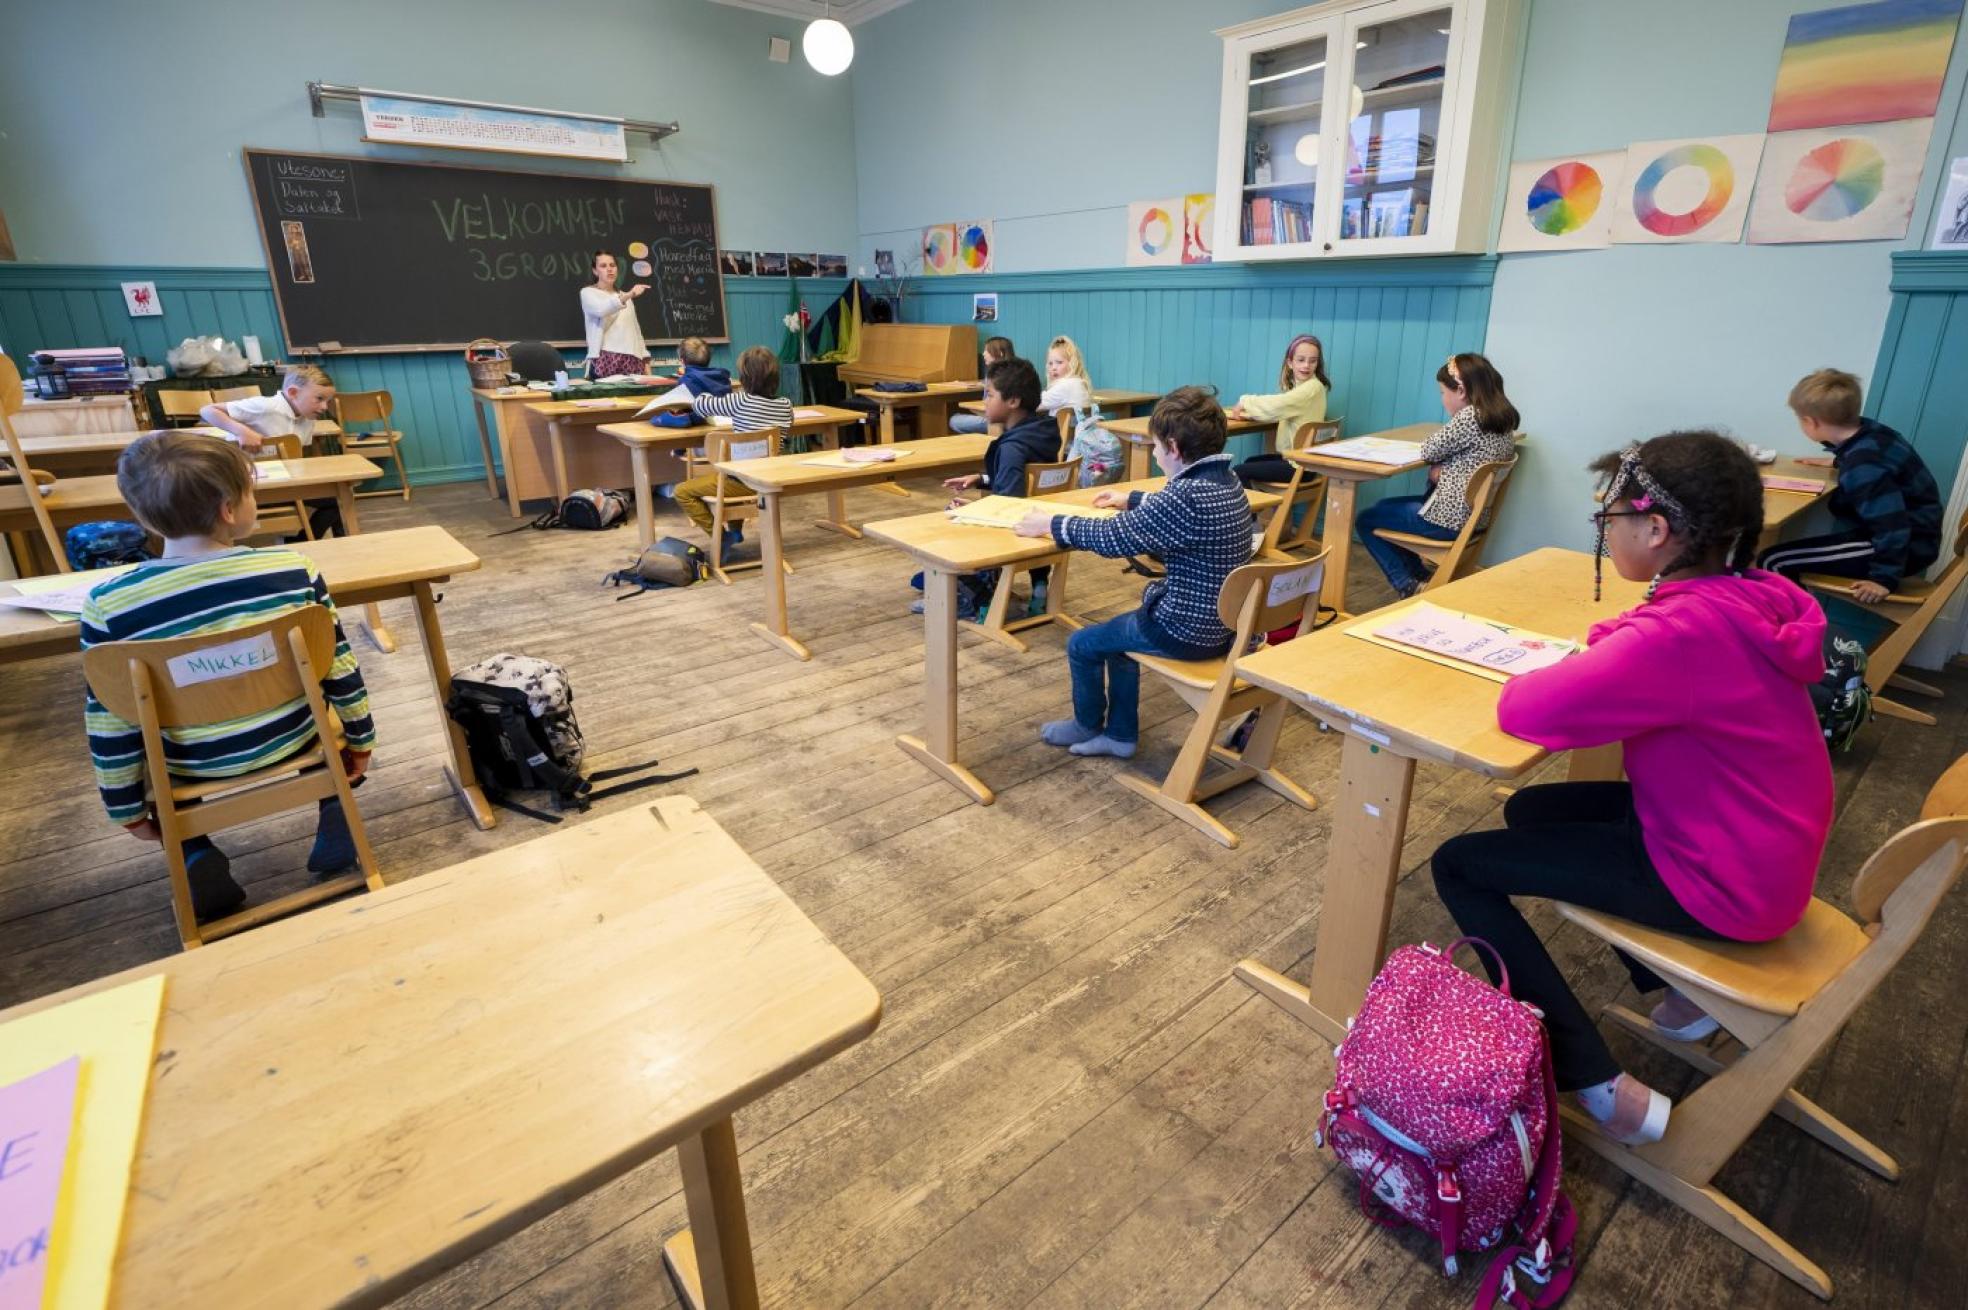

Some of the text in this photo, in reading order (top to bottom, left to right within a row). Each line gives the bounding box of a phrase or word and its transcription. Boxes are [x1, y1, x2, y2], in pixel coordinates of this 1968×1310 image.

[432, 194, 624, 243] VELKOMMEN
[469, 248, 593, 282] 3.GRØN
[187, 647, 277, 674] MIKKEL
